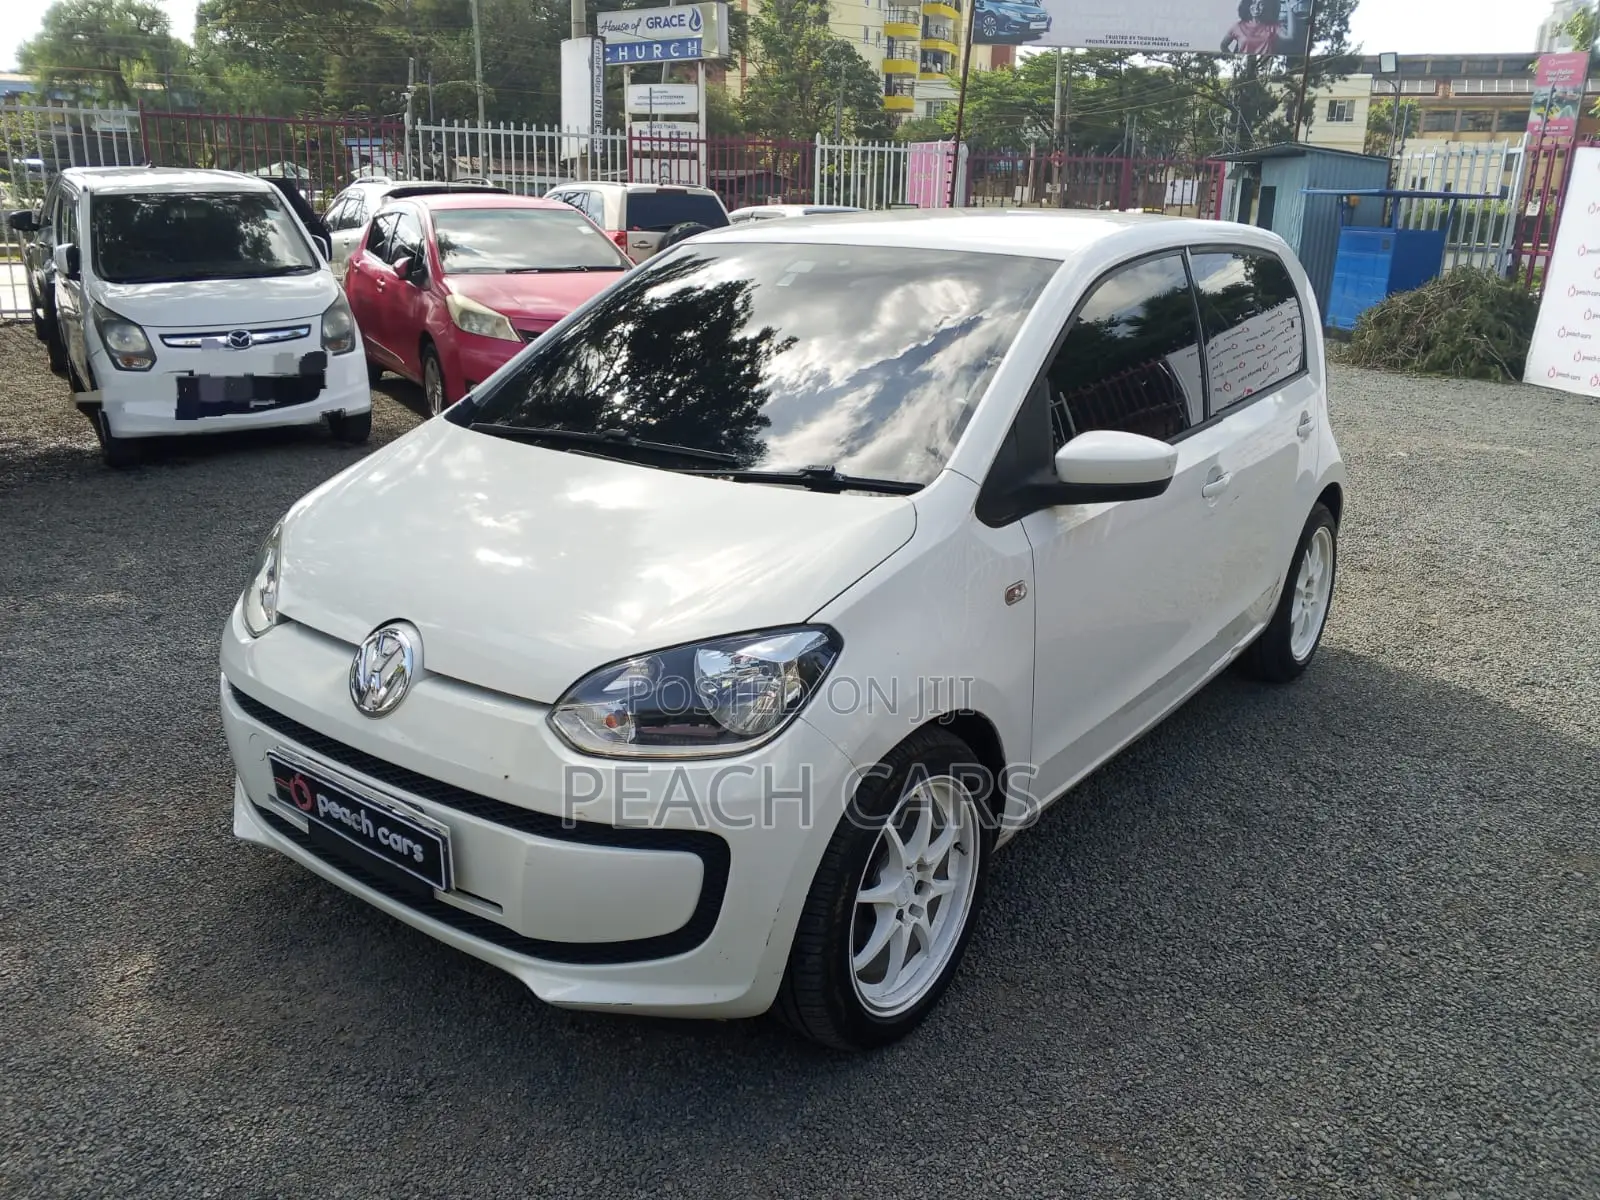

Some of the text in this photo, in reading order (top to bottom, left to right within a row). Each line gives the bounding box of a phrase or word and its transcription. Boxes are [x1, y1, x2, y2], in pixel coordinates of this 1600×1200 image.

[600, 14, 686, 36] House of GRACE
[316, 792, 424, 864] peach cars
